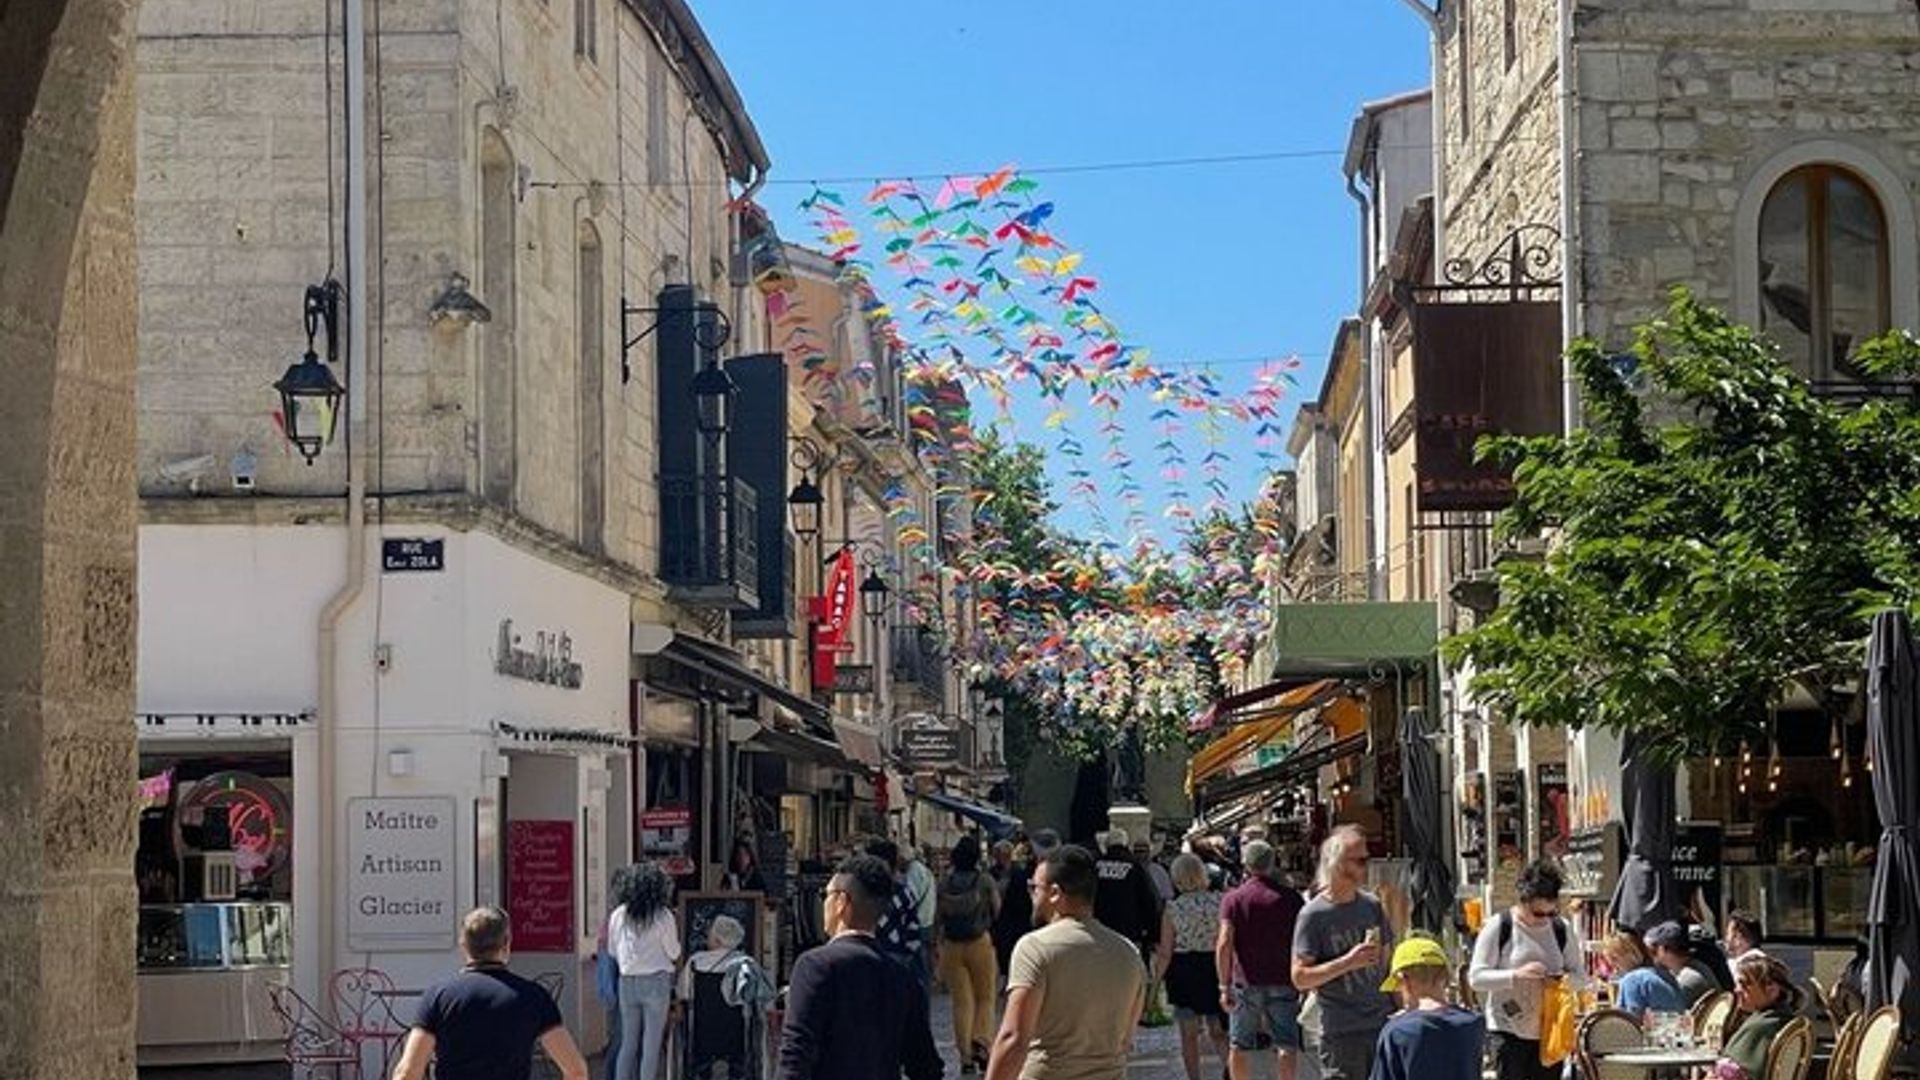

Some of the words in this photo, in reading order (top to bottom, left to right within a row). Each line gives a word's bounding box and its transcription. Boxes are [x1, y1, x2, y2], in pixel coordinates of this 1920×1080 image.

[402, 543, 422, 554] RUE
[411, 556, 437, 567] ZOLA
[831, 569, 847, 629] TABAC
[361, 855, 442, 874] Artisan
[360, 895, 442, 916] Glacier
